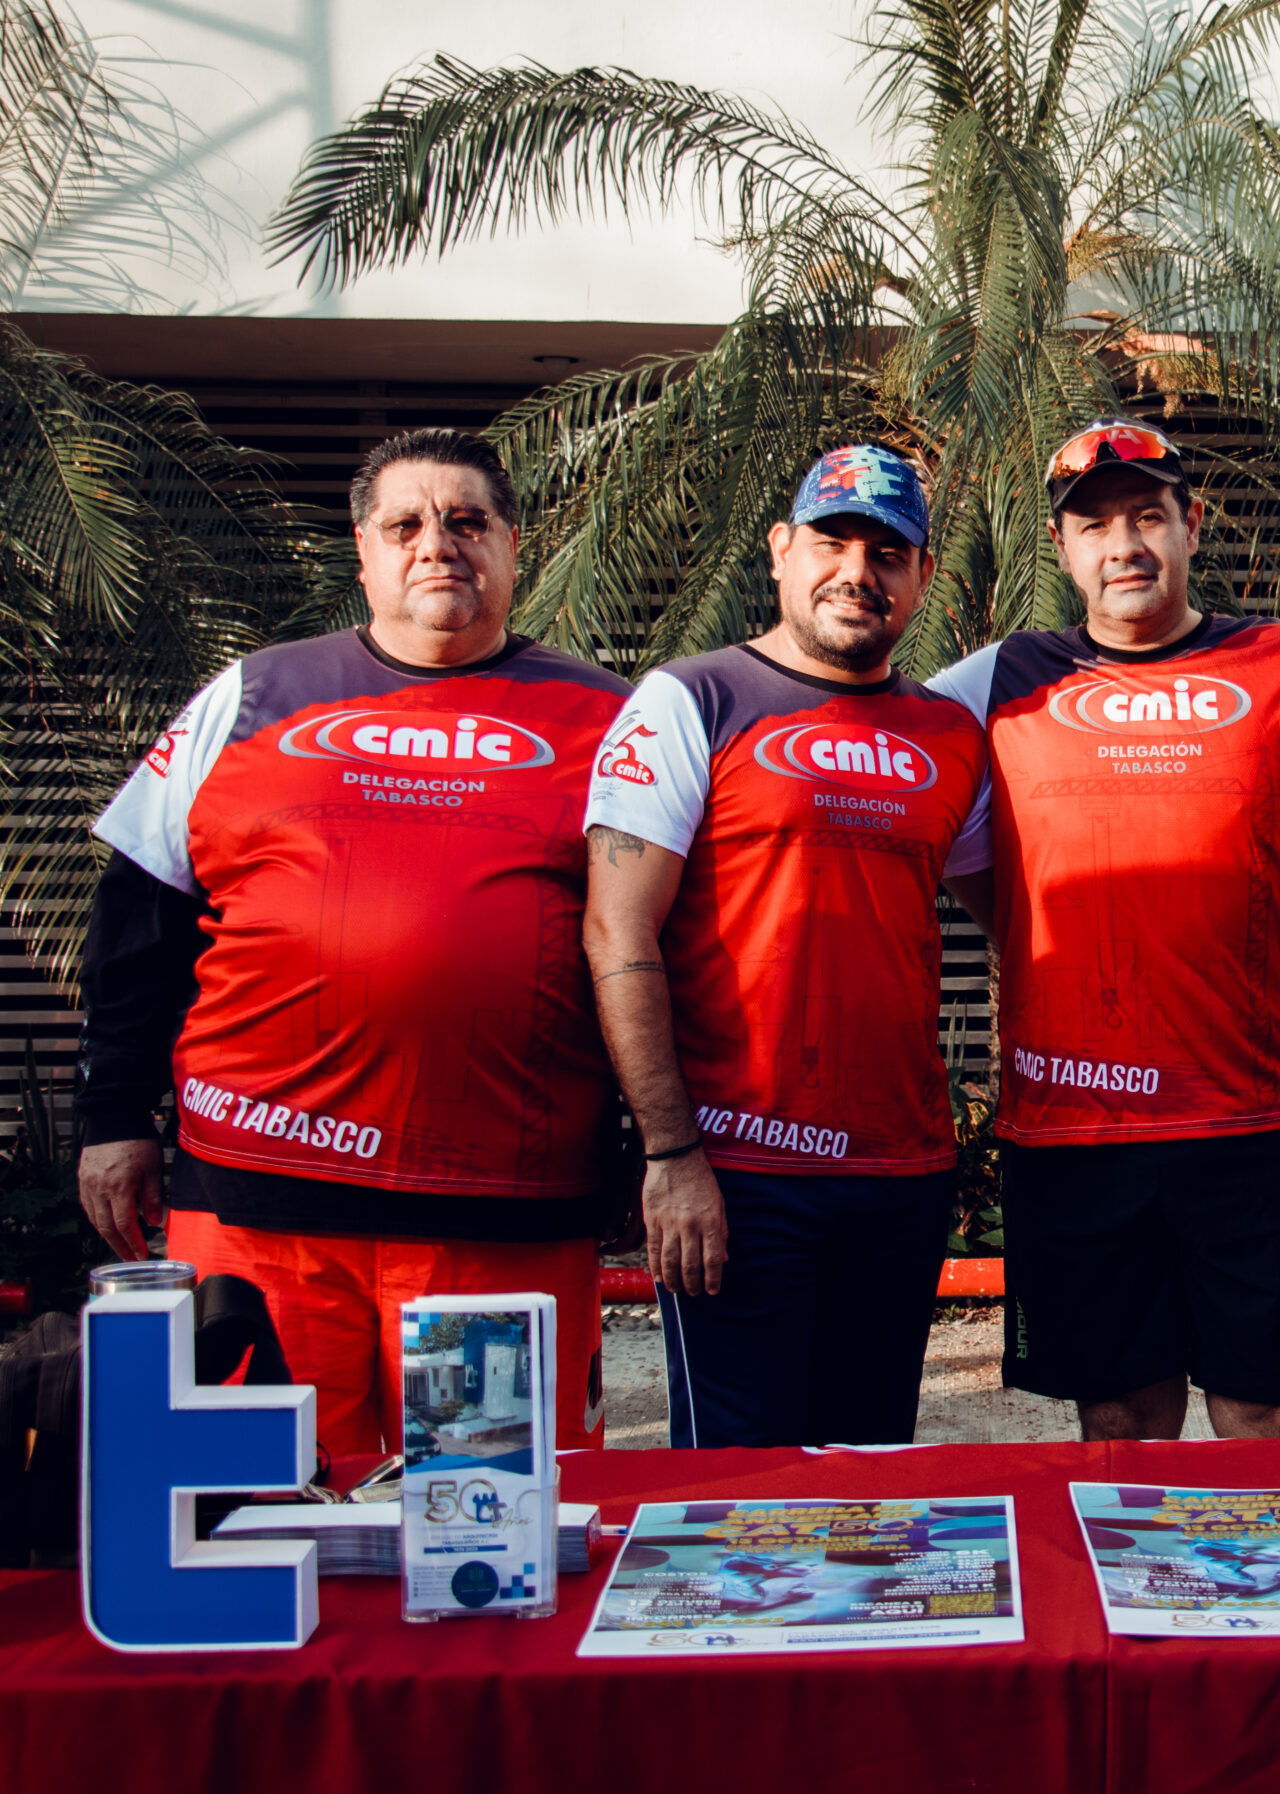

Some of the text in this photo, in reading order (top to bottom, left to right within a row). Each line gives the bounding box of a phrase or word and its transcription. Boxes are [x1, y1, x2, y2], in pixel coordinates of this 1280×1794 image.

[1103, 679, 1219, 723] cmic
[352, 718, 511, 762] cmic
[1097, 741, 1202, 758] DELEGACIÓN
[809, 734, 916, 782] cmic
[1112, 761, 1187, 774] TABASCO
[342, 770, 485, 793] DELEGACIÓN
[616, 763, 650, 783] cmic
[362, 789, 463, 807] TABASCO
[814, 794, 906, 816] DELEGACIÓN
[827, 812, 892, 831] TABASCO
[1015, 1048, 1159, 1095] CMIC TABASCO
[183, 1077, 382, 1158] CMIC TABASCO
[735, 1113, 848, 1158] TABASCO
[1152, 1509, 1271, 1524] CAT
[704, 1522, 830, 1538] CAT
